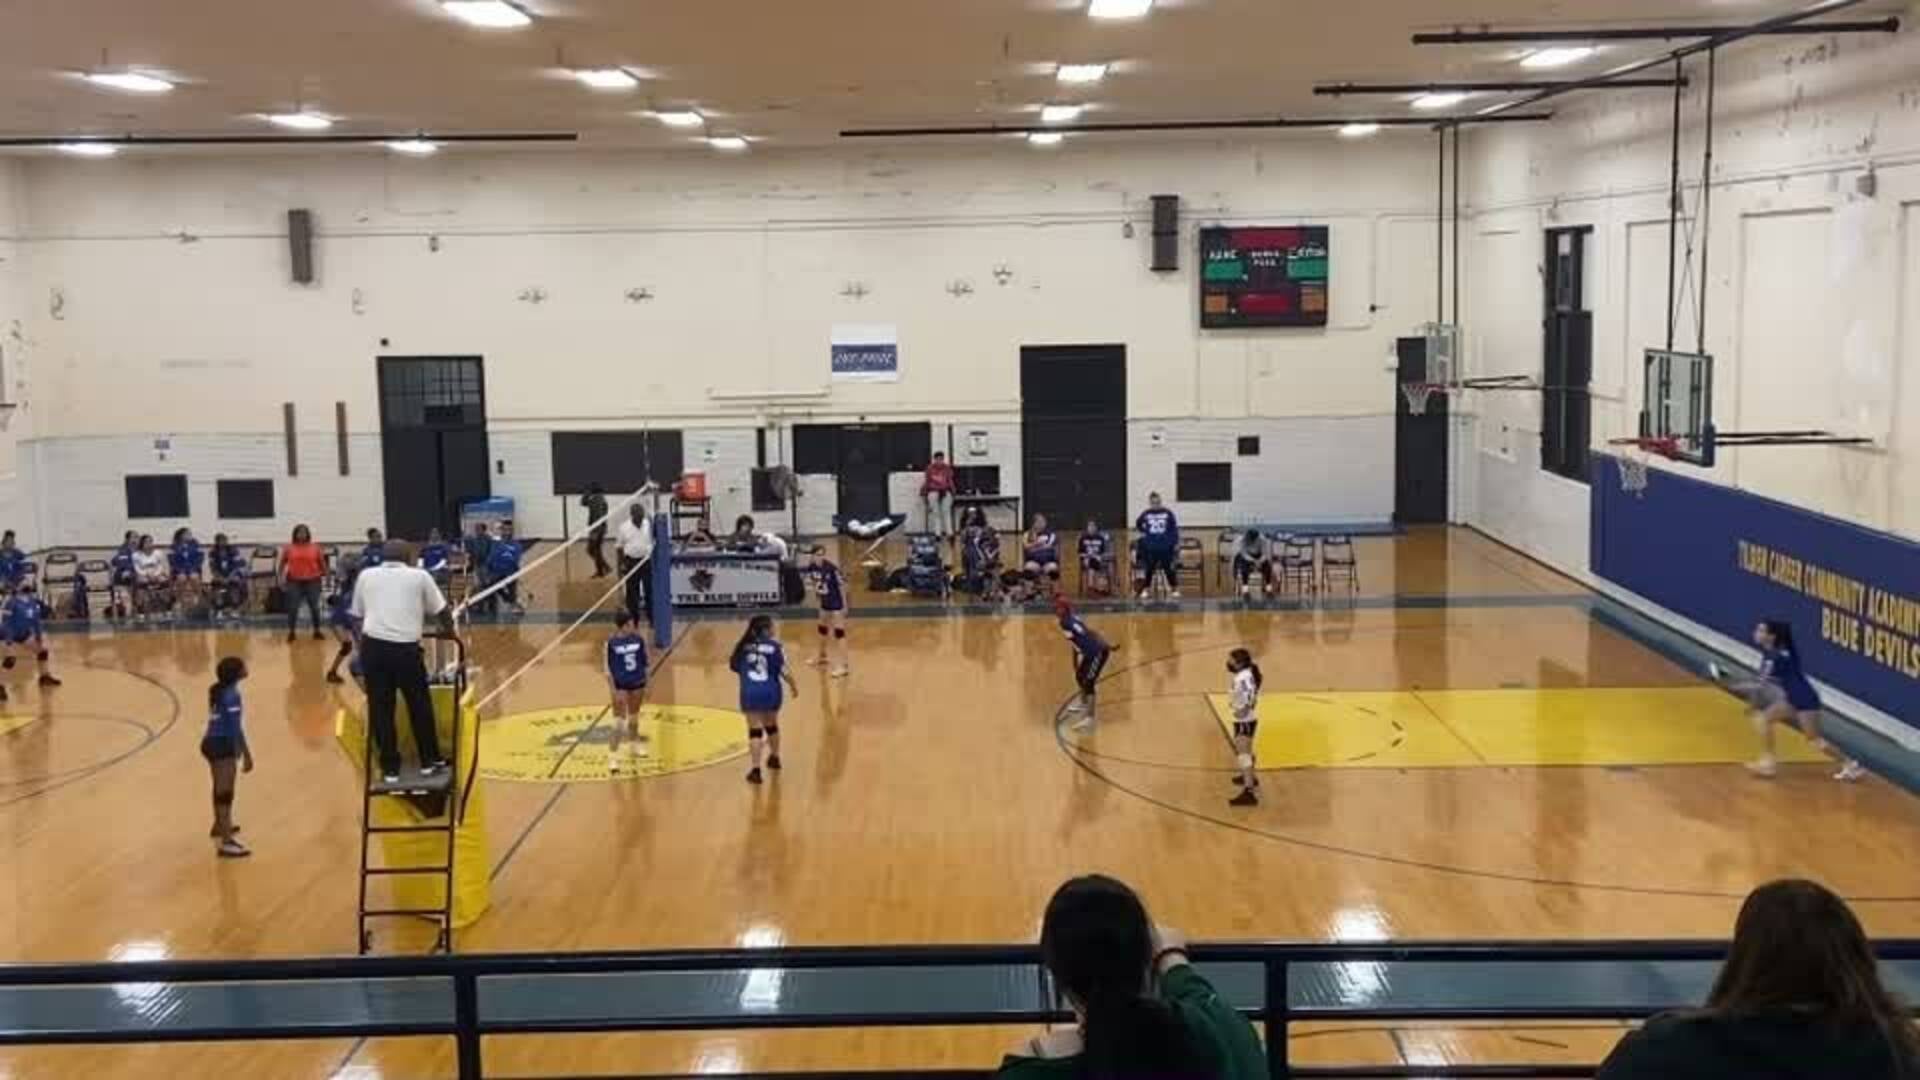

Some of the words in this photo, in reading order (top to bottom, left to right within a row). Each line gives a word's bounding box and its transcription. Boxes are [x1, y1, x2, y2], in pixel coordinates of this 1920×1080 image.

[1822, 606, 1860, 652] BLUE
[1863, 624, 1920, 679] DEVILS
[624, 653, 637, 672] 5
[746, 653, 769, 682] 3
